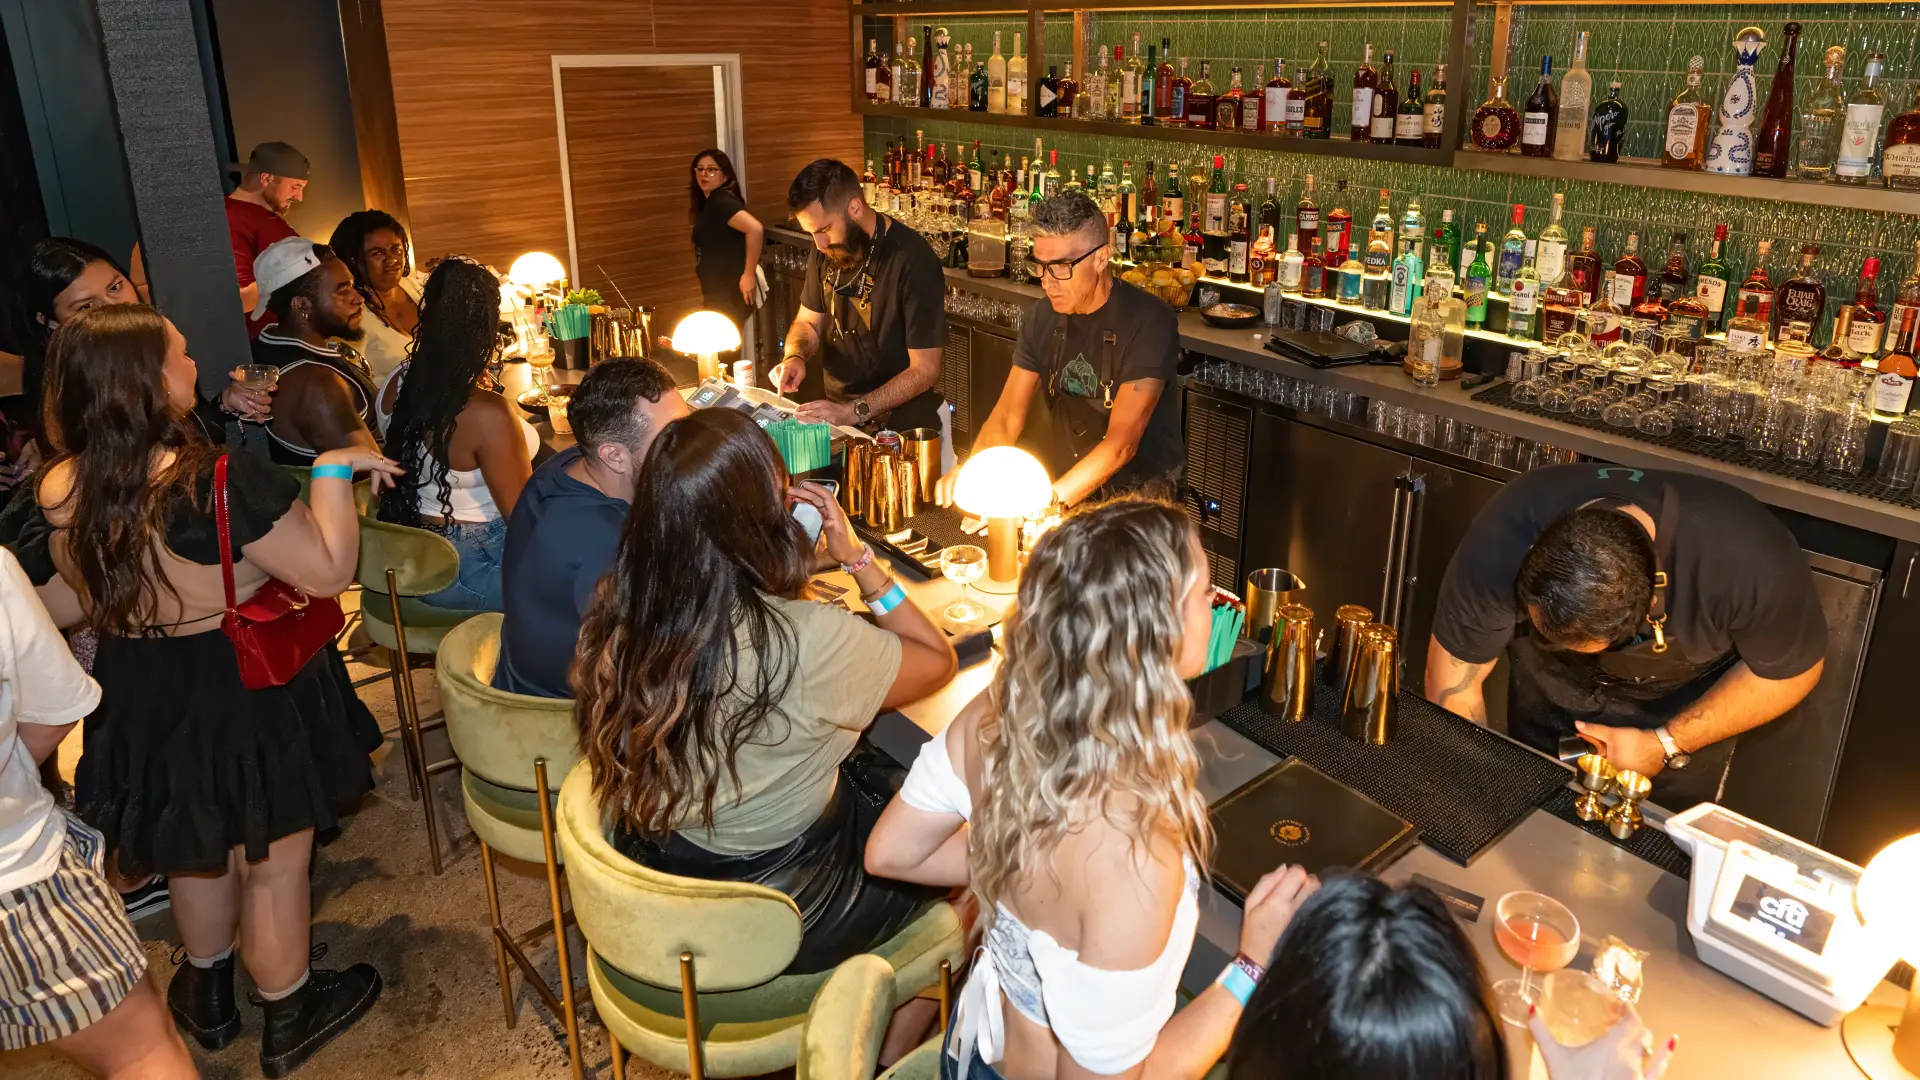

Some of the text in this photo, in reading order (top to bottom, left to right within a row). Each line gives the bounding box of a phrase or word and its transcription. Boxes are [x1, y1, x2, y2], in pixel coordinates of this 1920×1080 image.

[1884, 152, 1920, 164] WHISTLE
[1788, 288, 1815, 300] ELIJAH
[1786, 296, 1813, 308] CRAIG
[1852, 322, 1874, 331] ker's
[1760, 896, 1809, 929] citi
